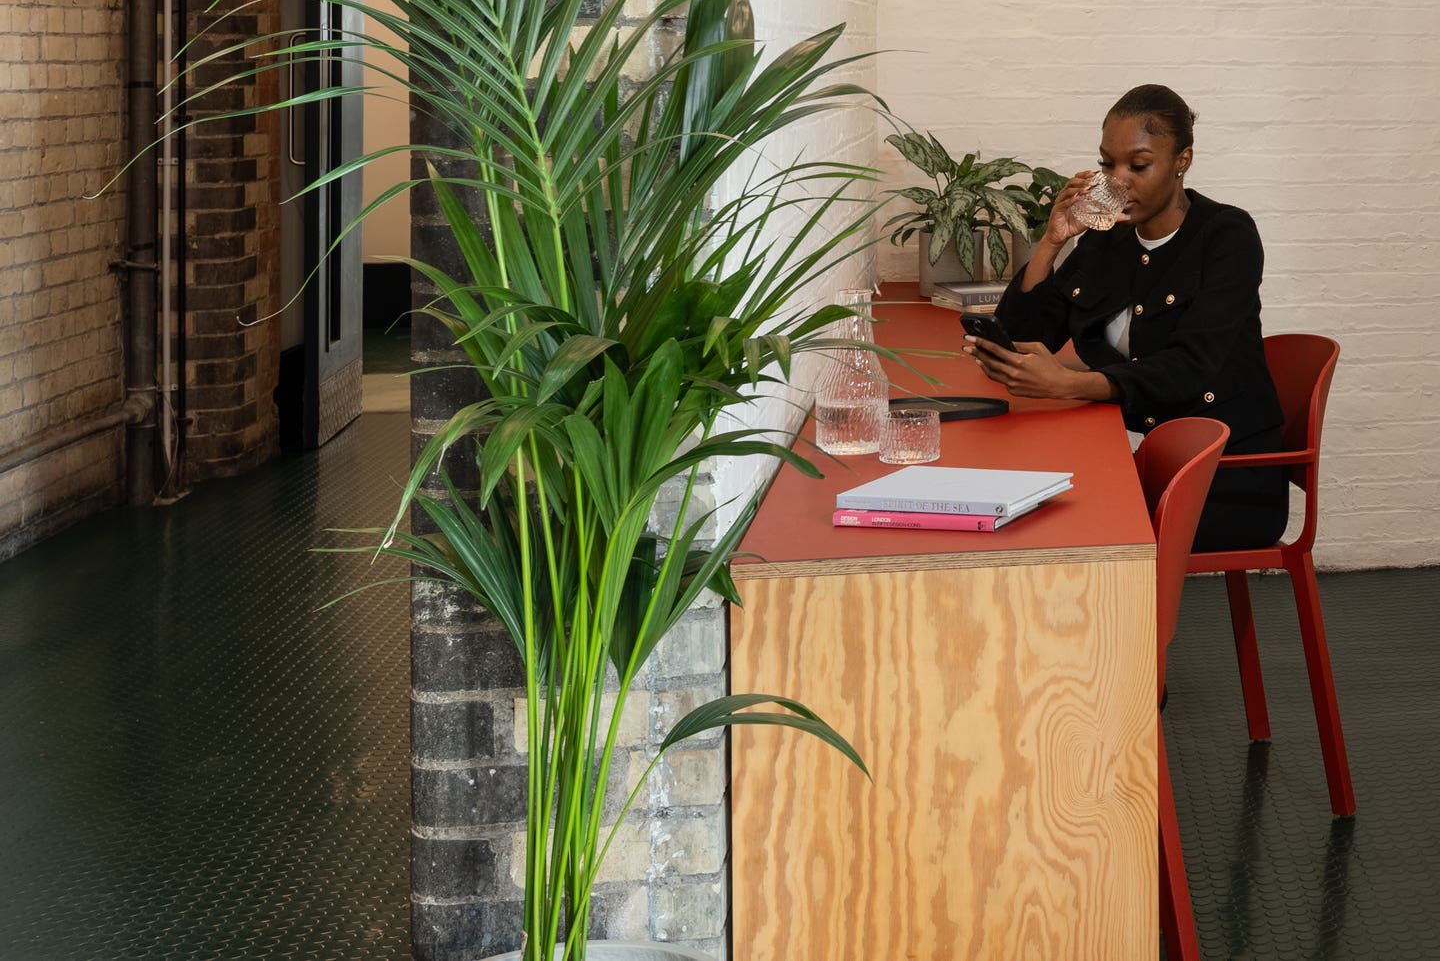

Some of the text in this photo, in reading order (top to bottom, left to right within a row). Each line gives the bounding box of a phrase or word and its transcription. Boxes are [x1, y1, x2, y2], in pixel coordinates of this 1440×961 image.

[979, 294, 1000, 303] LUM
[882, 500, 914, 510] SPIRIT
[916, 501, 929, 511] OF
[931, 502, 951, 512] THE
[953, 503, 971, 513] SEA
